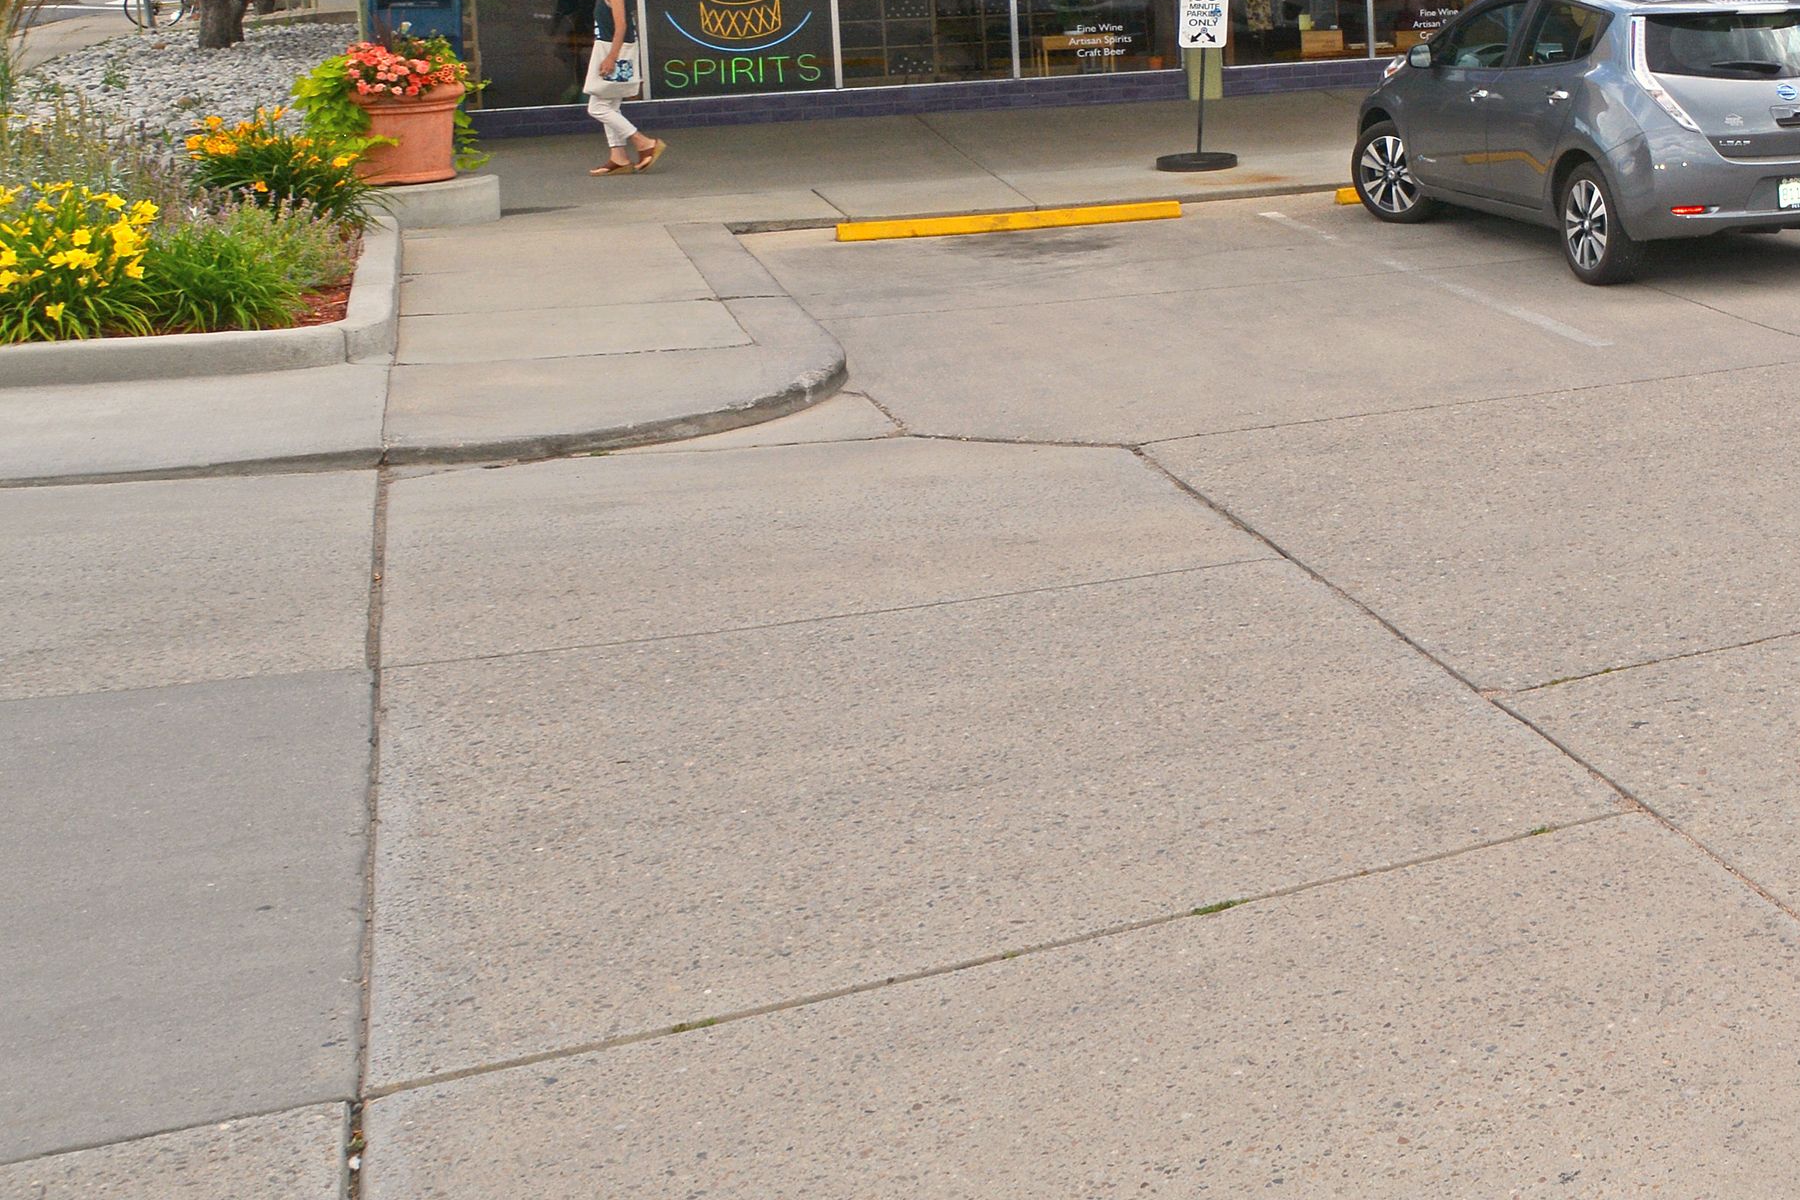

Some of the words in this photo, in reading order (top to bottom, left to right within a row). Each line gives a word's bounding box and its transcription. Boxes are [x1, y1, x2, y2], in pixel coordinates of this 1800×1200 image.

[1419, 8, 1437, 17] Fine
[1437, 7, 1459, 16] Wine
[1188, 18, 1218, 27] ONLY
[1412, 20, 1441, 29] Artisan
[1076, 24, 1097, 33] Fine
[1098, 23, 1124, 32] Wine
[1068, 37, 1102, 46] Artisan
[1103, 35, 1133, 46] Spirits
[1076, 48, 1102, 58] Craft
[1103, 47, 1127, 56] Beer
[664, 53, 822, 89] SPIRITS
